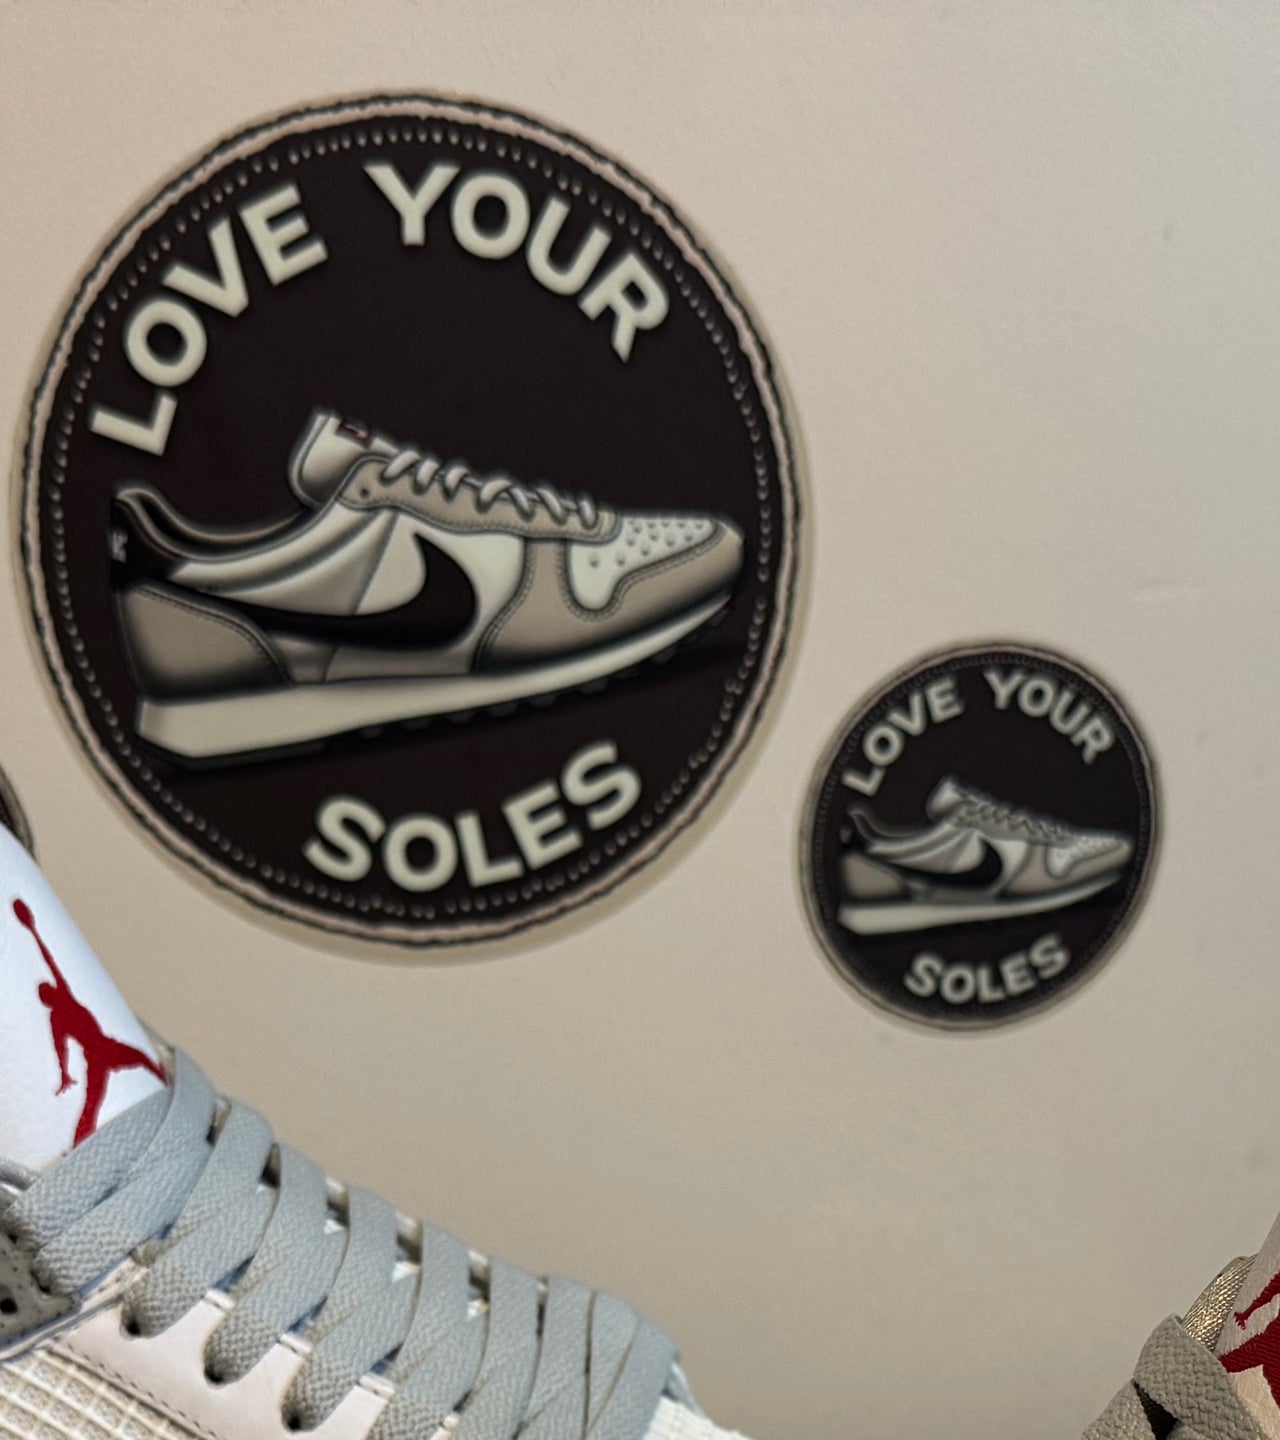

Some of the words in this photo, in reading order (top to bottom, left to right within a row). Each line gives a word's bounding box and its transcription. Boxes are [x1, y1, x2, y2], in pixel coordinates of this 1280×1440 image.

[90, 185, 328, 457] LOVE
[363, 160, 671, 363] YOUR
[841, 677, 964, 797] LOVE
[983, 668, 1116, 765] YOUR
[302, 741, 643, 893] SOLES
[902, 934, 1070, 1004] SOLES
